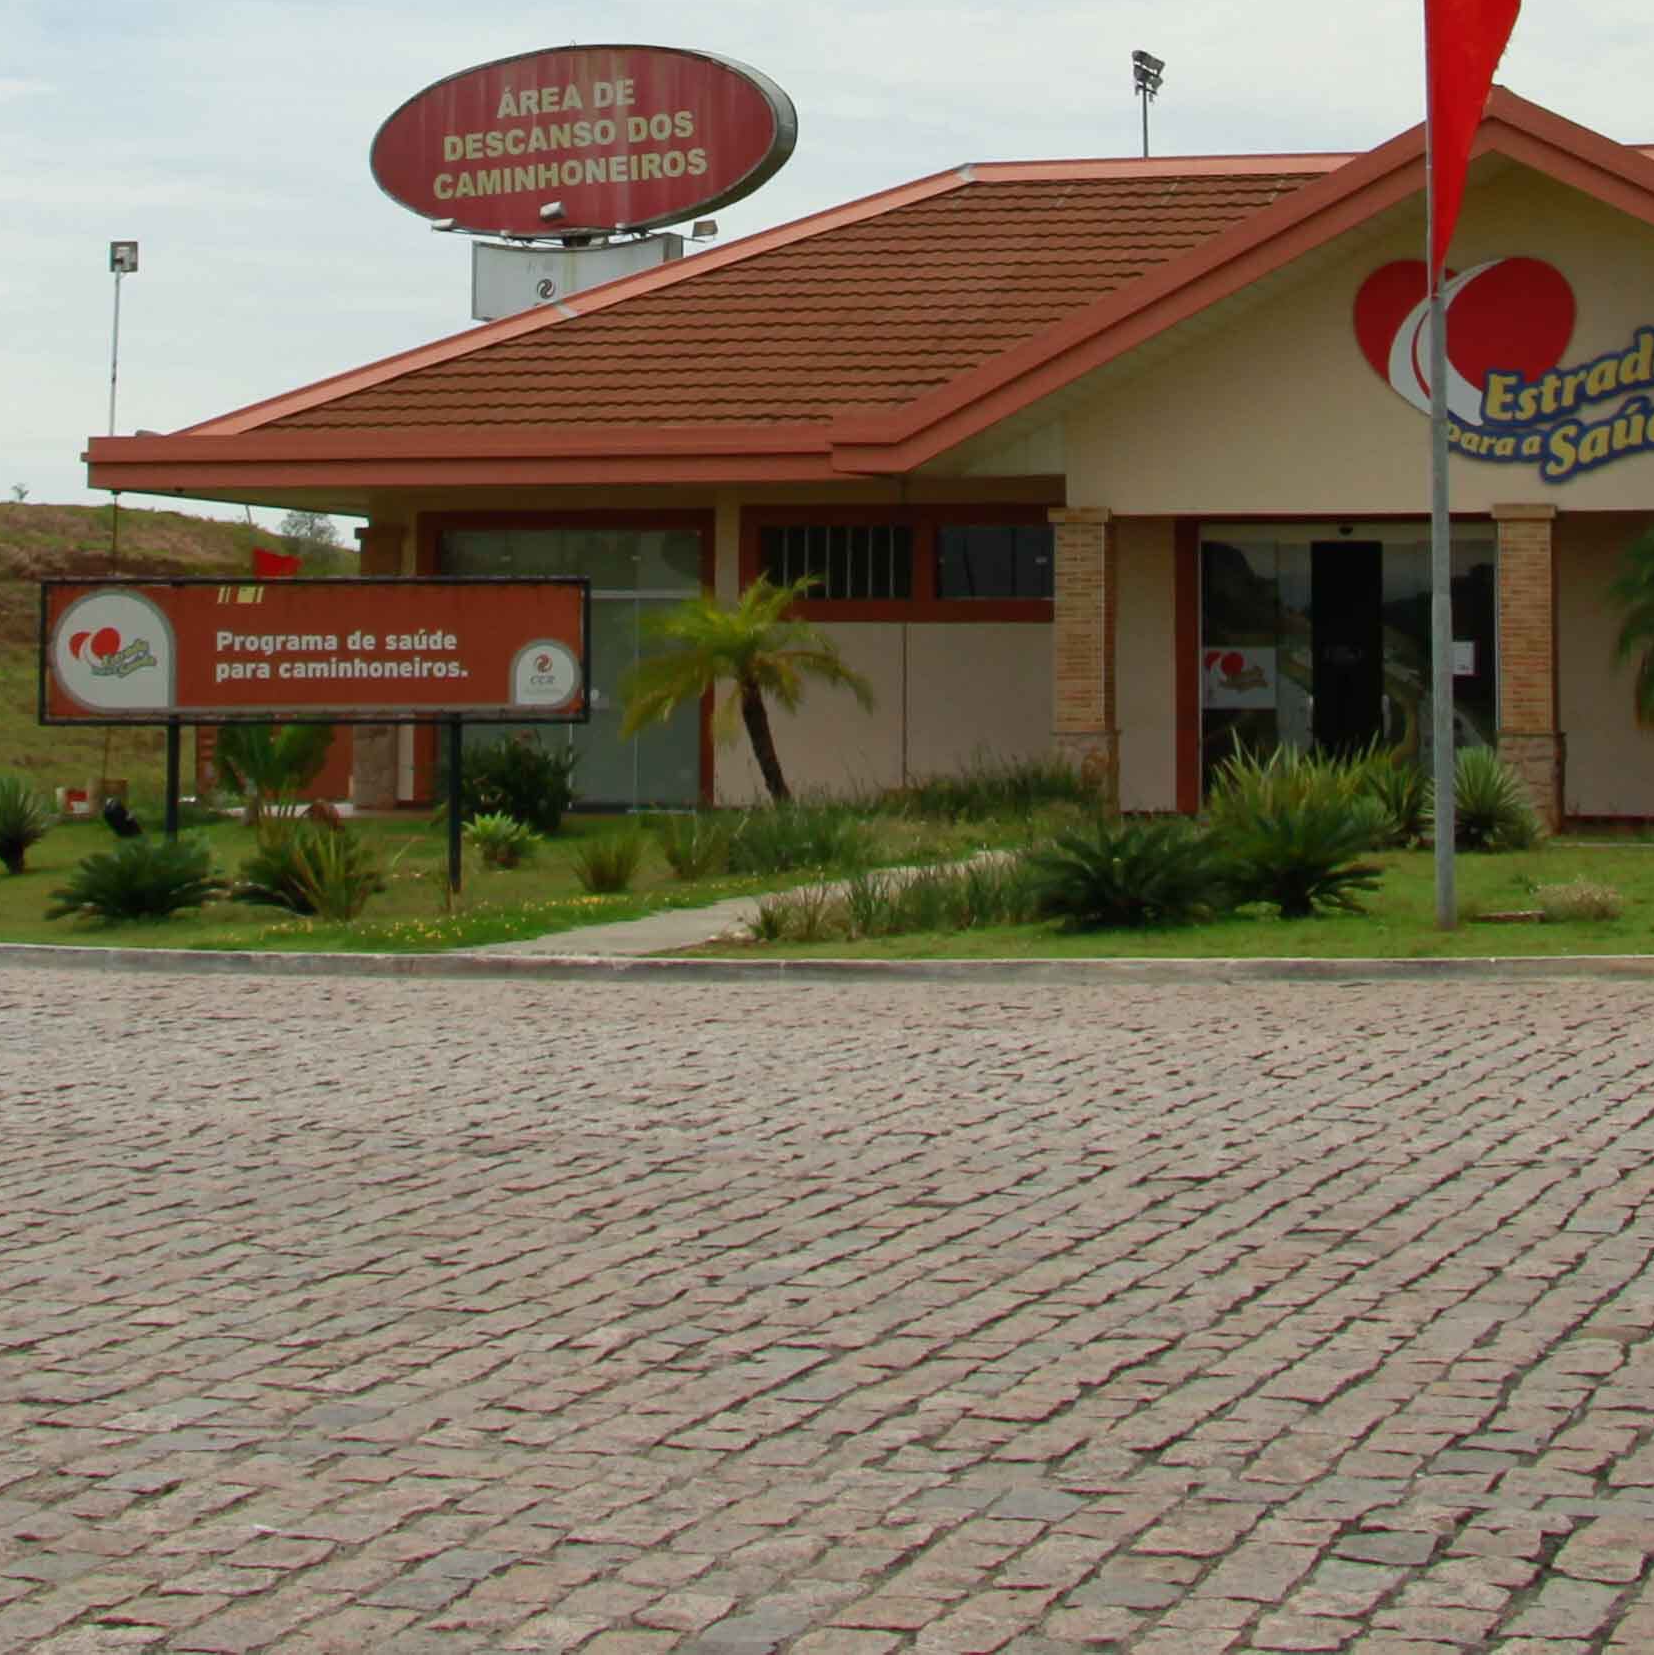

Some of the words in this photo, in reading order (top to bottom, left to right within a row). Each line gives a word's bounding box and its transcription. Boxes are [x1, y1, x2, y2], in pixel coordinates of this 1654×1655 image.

[496, 83, 583, 119] ÁREA
[593, 79, 635, 108] DE
[444, 119, 616, 162] DESCANSO
[627, 111, 694, 143] DOS
[433, 148, 709, 200] CAMINHONEIROS
[1522, 435, 1542, 455] a
[216, 630, 337, 656] Programa
[347, 630, 376, 650] de
[385, 628, 457, 650] saúde
[216, 662, 270, 682] para
[279, 657, 468, 679] caminhoneiros.
